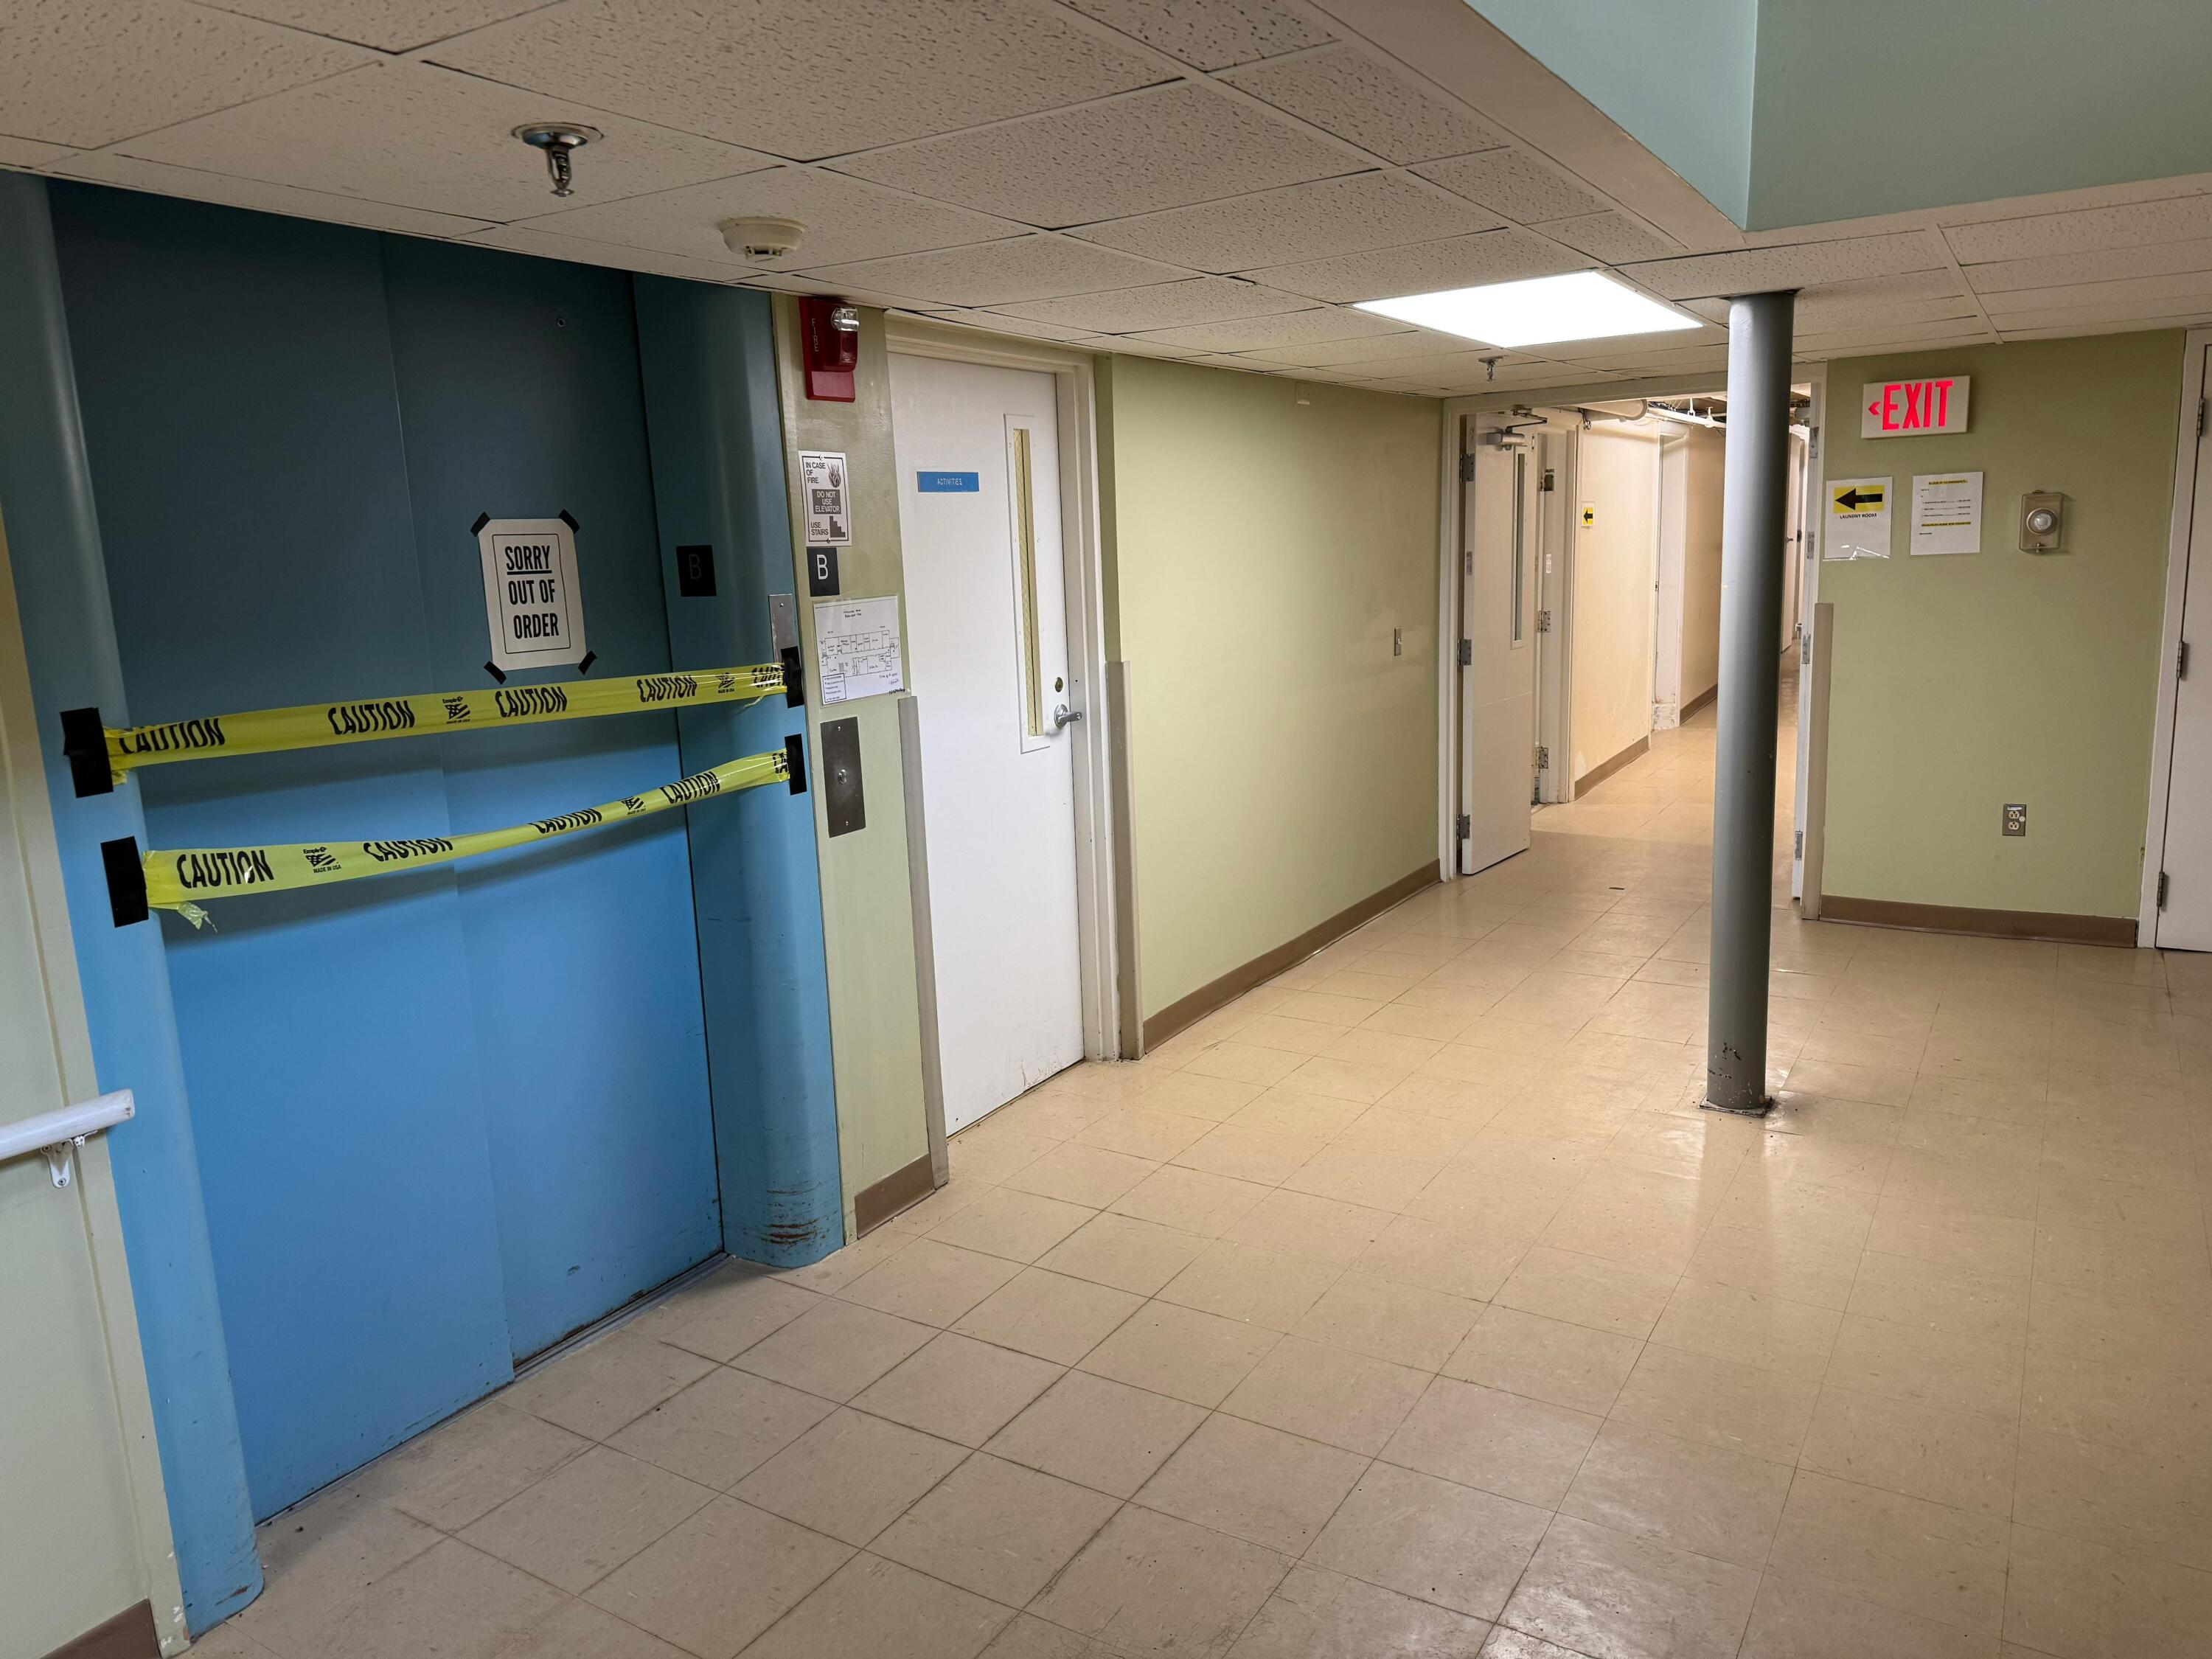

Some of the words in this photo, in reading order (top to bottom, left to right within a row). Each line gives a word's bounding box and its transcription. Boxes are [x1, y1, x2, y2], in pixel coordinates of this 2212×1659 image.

[1882, 380, 1953, 431] EXIT
[504, 545, 550, 570] SORRY
[689, 554, 701, 580] B
[816, 554, 828, 580] B
[508, 580, 535, 605] OUT
[538, 579, 554, 603] OF
[513, 613, 559, 639] ORDER
[495, 686, 567, 718] CAUTION
[637, 675, 698, 703] CAUTION
[328, 700, 415, 735] CAUTION
[119, 717, 226, 754] CAUTION
[659, 771, 720, 804] CAUTION
[528, 808, 602, 834] CAUTION
[364, 838, 453, 862] CAUTION
[176, 849, 274, 888] CAUTION
